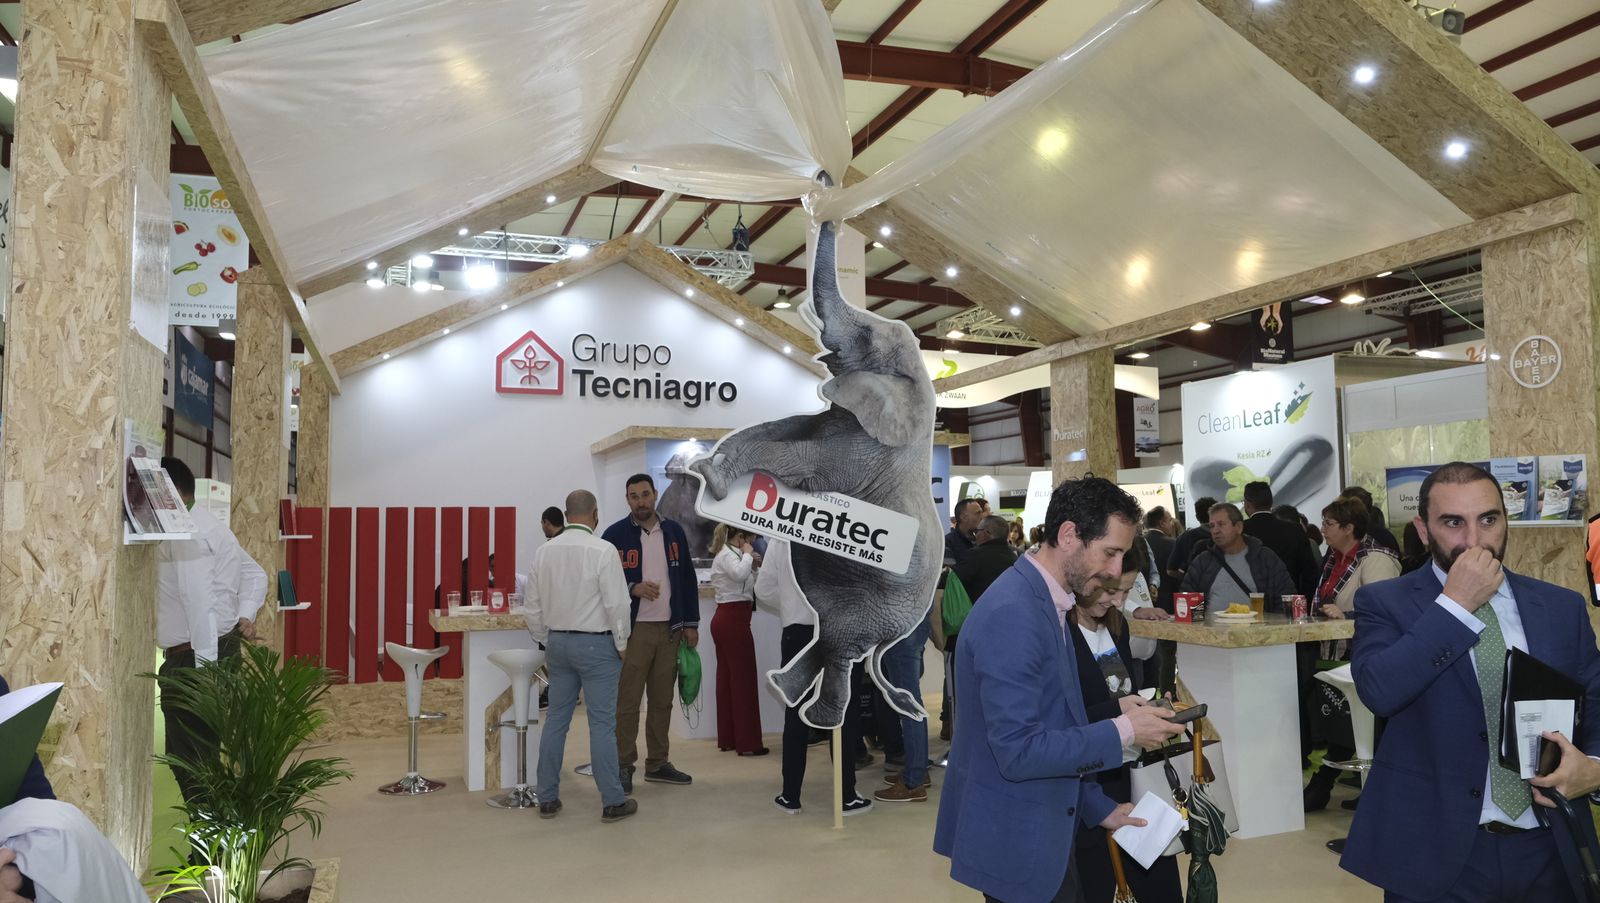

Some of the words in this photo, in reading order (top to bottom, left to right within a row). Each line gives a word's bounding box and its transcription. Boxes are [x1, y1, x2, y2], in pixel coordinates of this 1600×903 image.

[174, 311, 207, 319] desde
[211, 313, 235, 321] 1999
[572, 334, 672, 370] Grupo
[1514, 355, 1557, 369] BAYER
[1530, 340, 1541, 384] BAYER
[572, 369, 738, 408] Tecniagro
[1053, 429, 1084, 441] Duratec
[1198, 402, 1281, 435] CleanLeaf
[746, 471, 889, 551] Duratec
[1399, 494, 1414, 502] Una
[741, 512, 774, 530] DURA
[777, 523, 805, 542] MÁS,
[809, 533, 857, 555] RESISTE
[859, 549, 883, 563] MÁS
